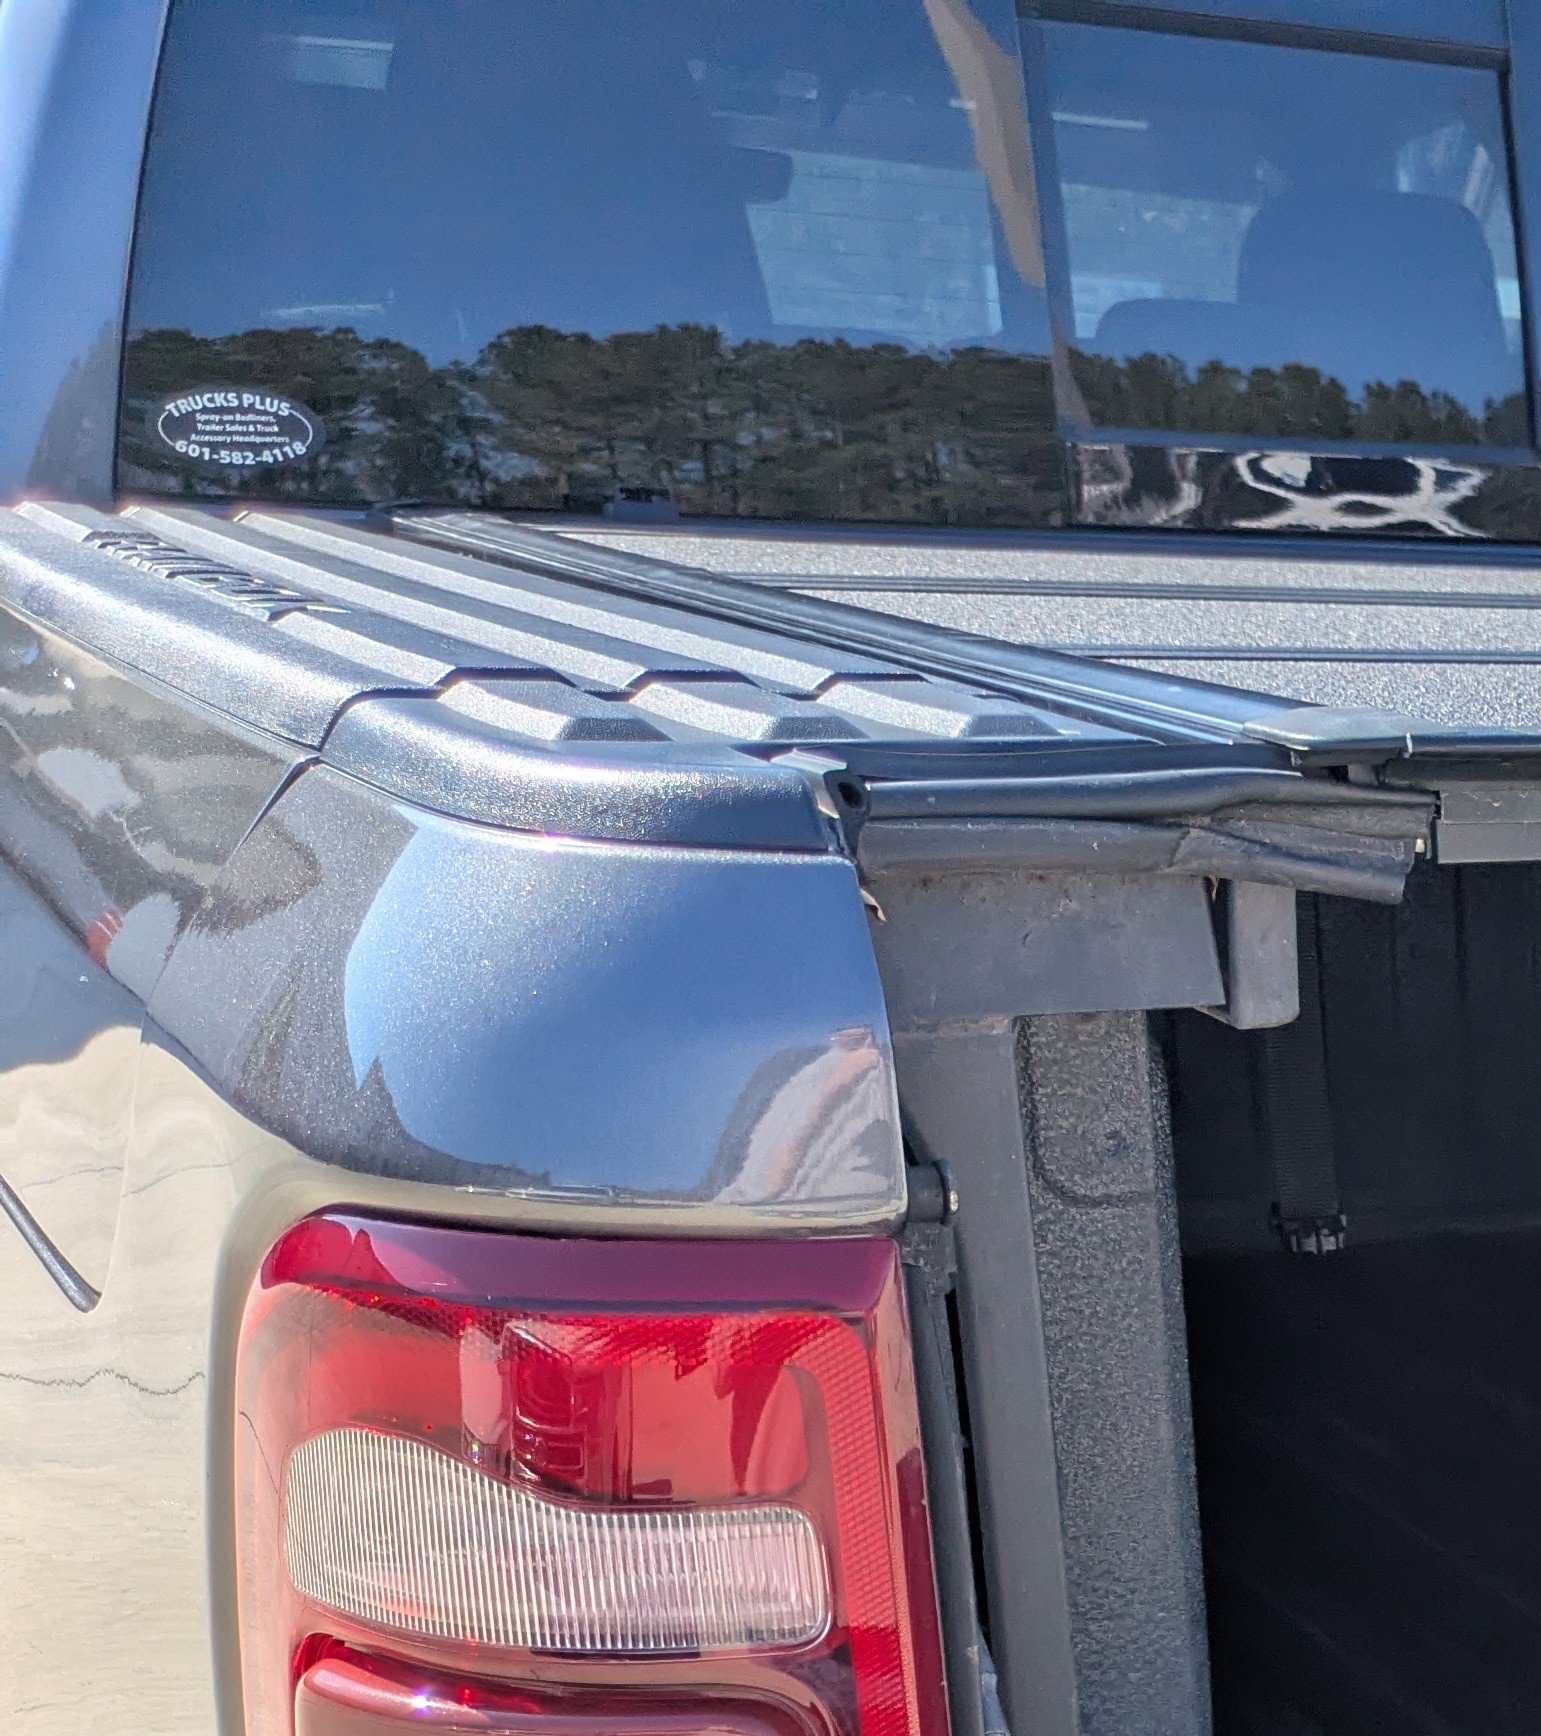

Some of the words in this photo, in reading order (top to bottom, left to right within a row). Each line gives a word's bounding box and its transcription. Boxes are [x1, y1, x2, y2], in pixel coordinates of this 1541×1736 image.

[165, 392, 239, 417] TRUCKS
[242, 393, 292, 416] PLUS
[195, 412, 234, 423] Spray-on
[235, 413, 277, 423] Bedliners,
[196, 422, 224, 432] Trailer
[225, 423, 247, 432] Sales
[248, 424, 255, 432] &
[256, 424, 279, 433] Truck
[190, 433, 231, 443] Accessory
[232, 434, 290, 444] Headquarters
[174, 440, 307, 465] 601-582-4118
